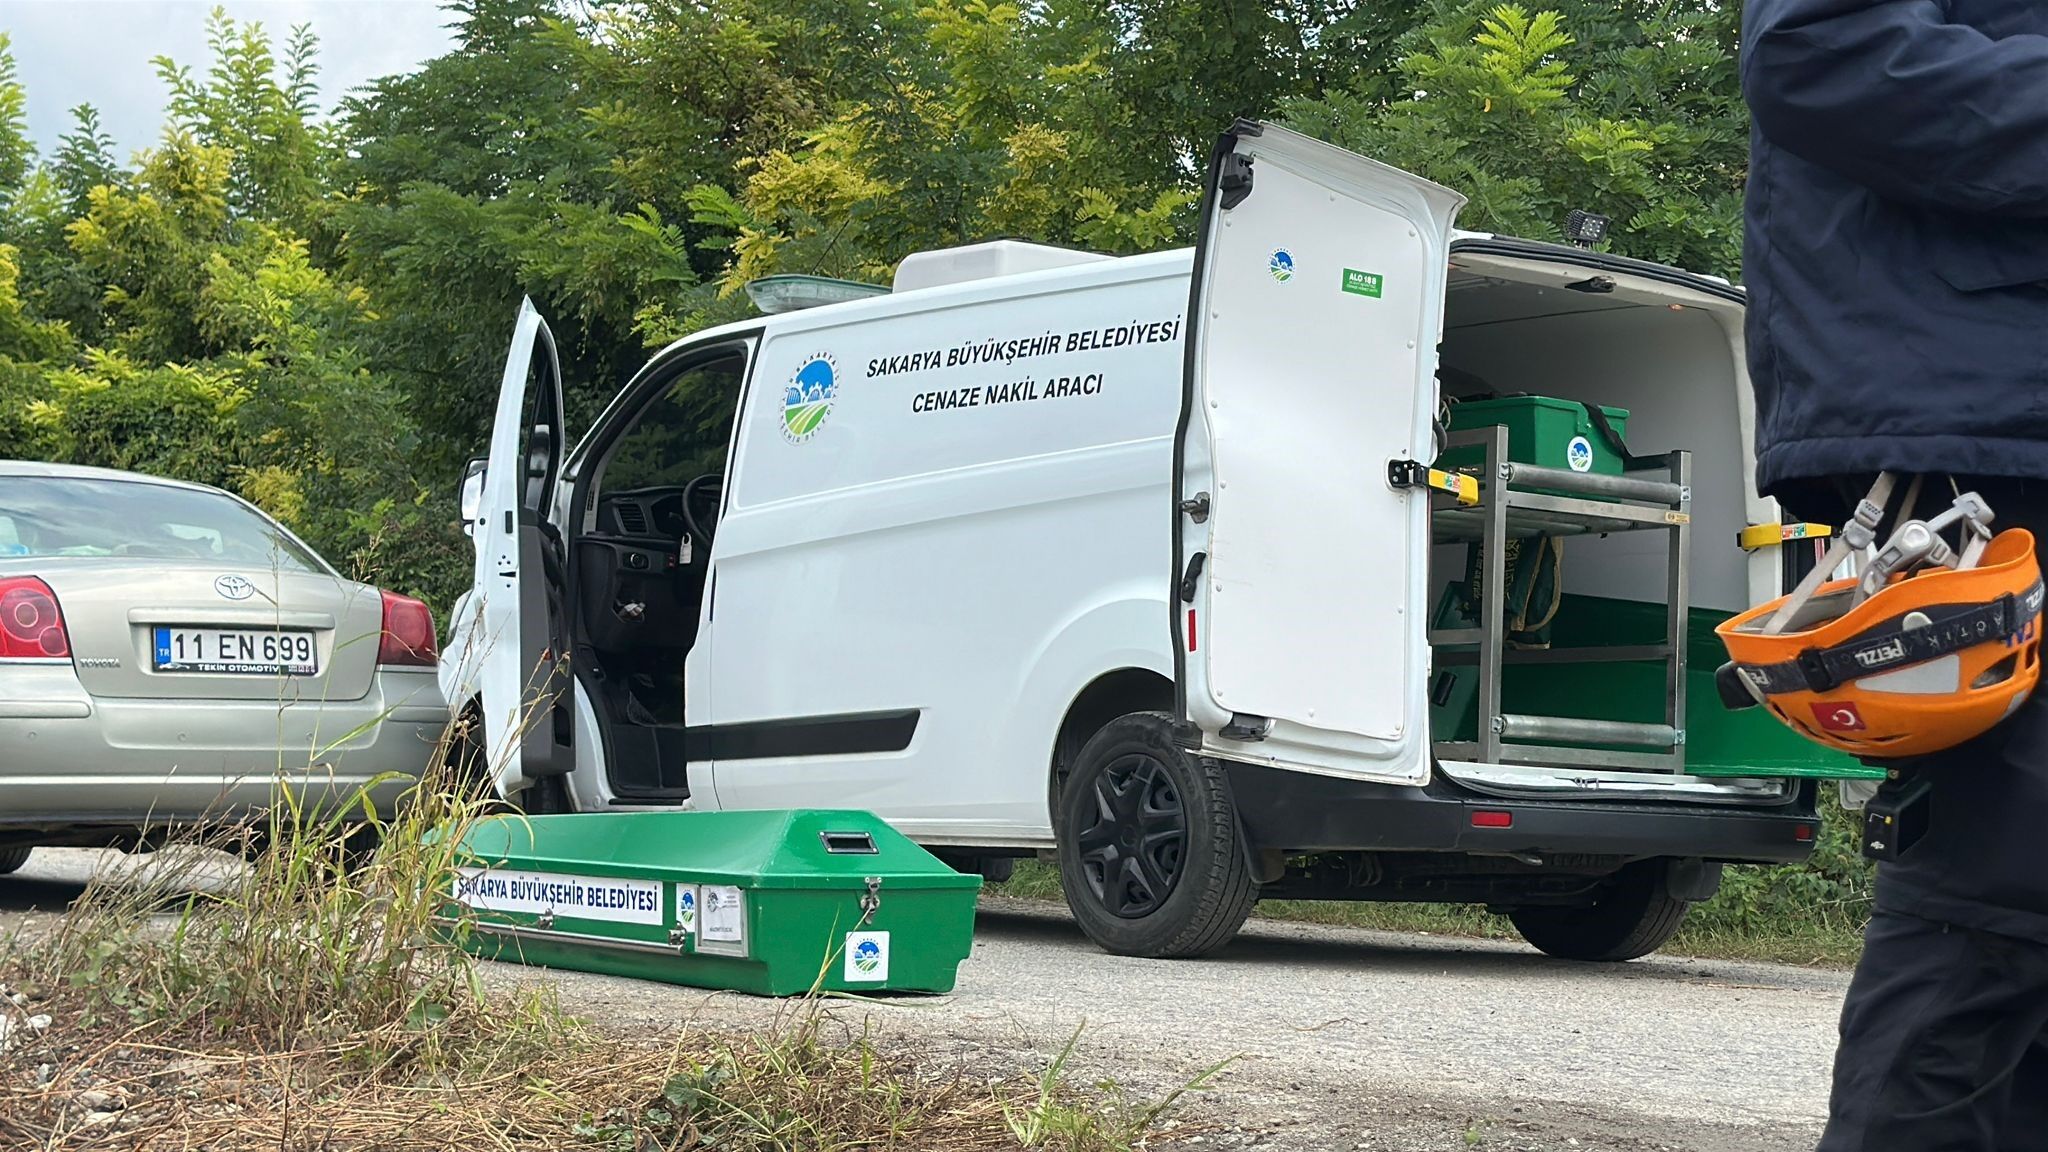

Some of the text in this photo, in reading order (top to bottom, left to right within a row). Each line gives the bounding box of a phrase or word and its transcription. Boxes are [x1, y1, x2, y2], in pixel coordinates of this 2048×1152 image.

[866, 314, 1182, 378] SAKARYA BÜYÜKŞEHİR BELEDİYESİ
[912, 374, 1104, 413] CENAZE NAKİL ARACI
[159, 648, 170, 657] TR
[175, 634, 309, 661] 11 EN 699
[1855, 638, 1905, 665] PETZL
[80, 658, 121, 668] TOYOTA
[229, 664, 279, 672] OTOMOTİV
[458, 877, 507, 899] SAKARYA
[511, 876, 583, 909] BÜYÜKŞEHİR
[587, 881, 659, 912] BELEDİYESİ
